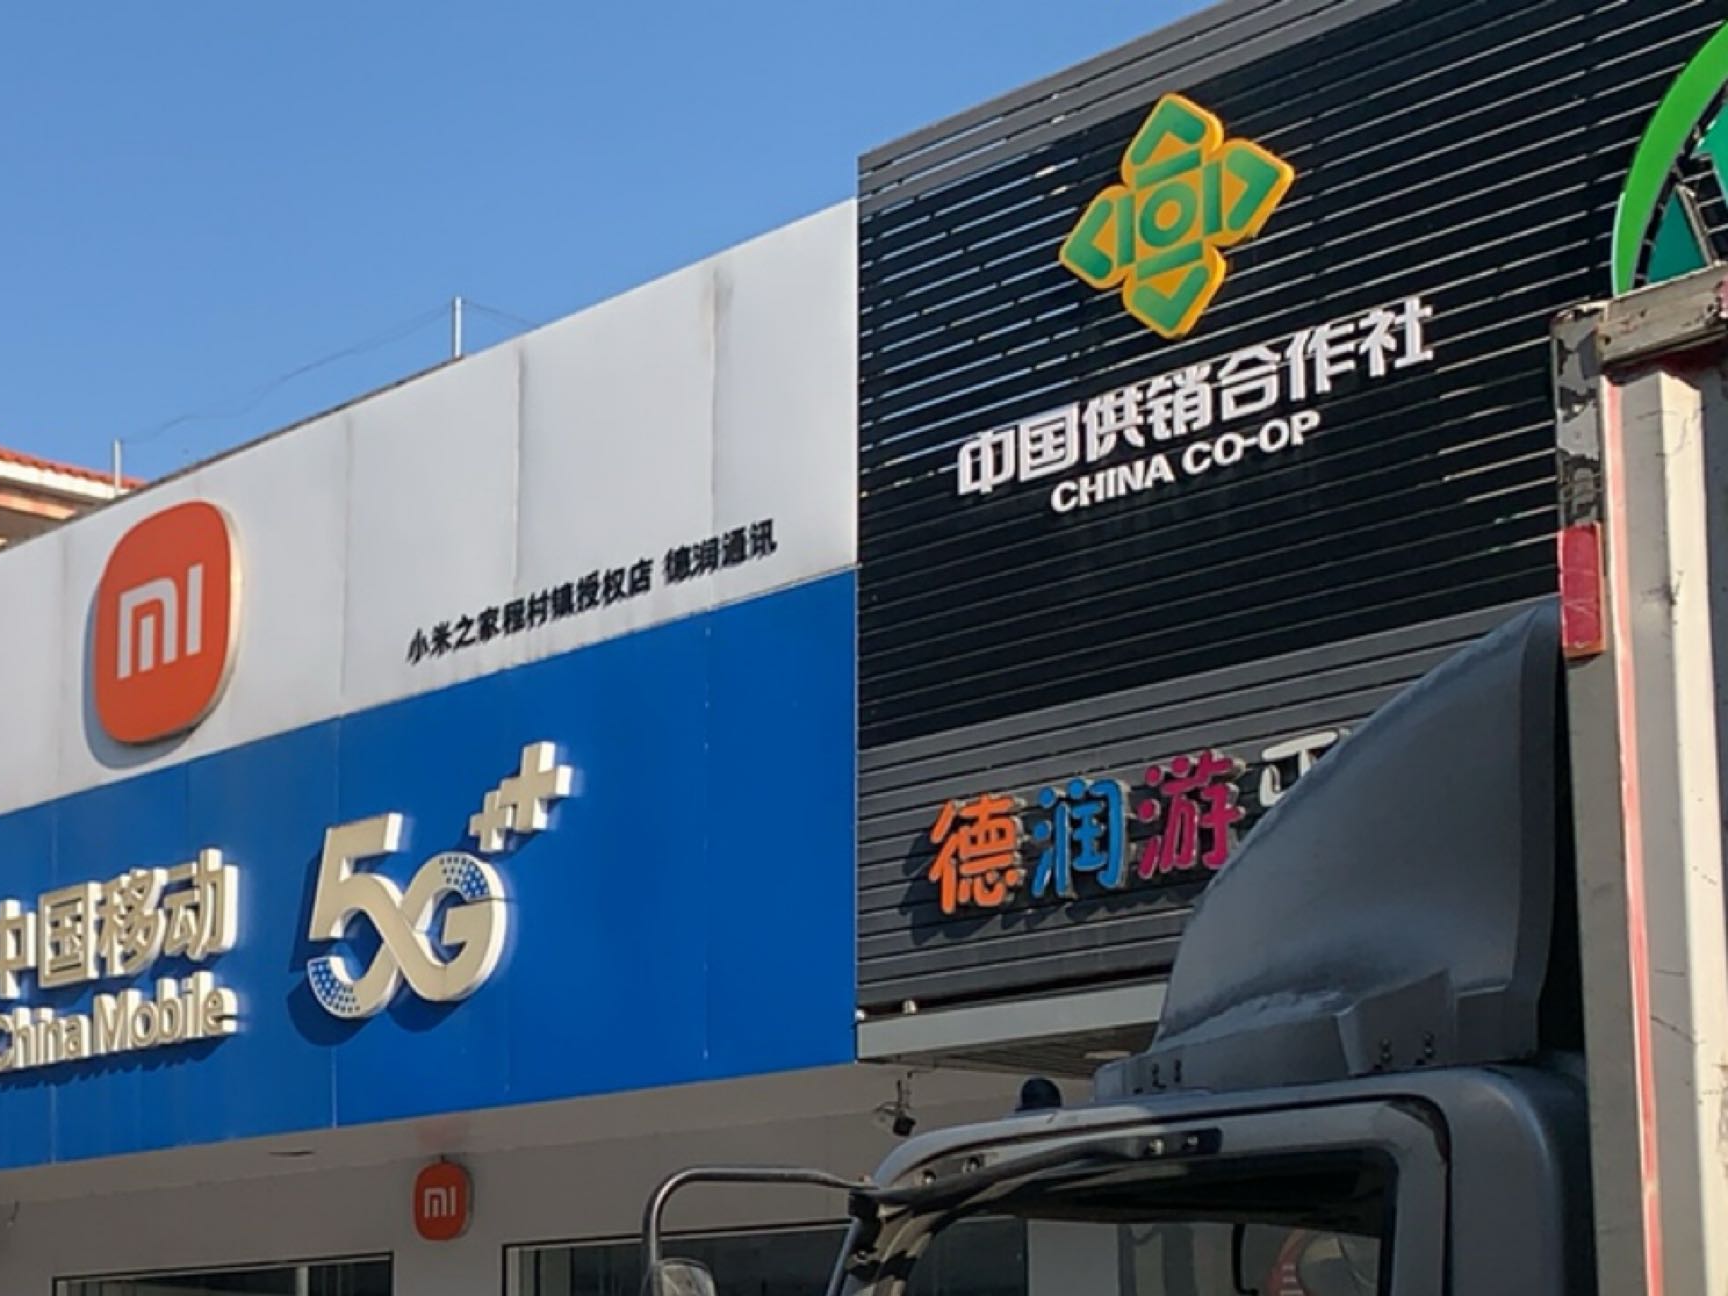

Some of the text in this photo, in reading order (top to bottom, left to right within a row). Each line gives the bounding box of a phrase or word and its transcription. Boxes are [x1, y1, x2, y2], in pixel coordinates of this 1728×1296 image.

[957, 296, 1434, 497] 中国供销合作社
[1050, 409, 1321, 514] CHINA CO-OP
[407, 557, 655, 666] 小米之家程村镇授权店
[93, 970, 240, 1056] Mobile
